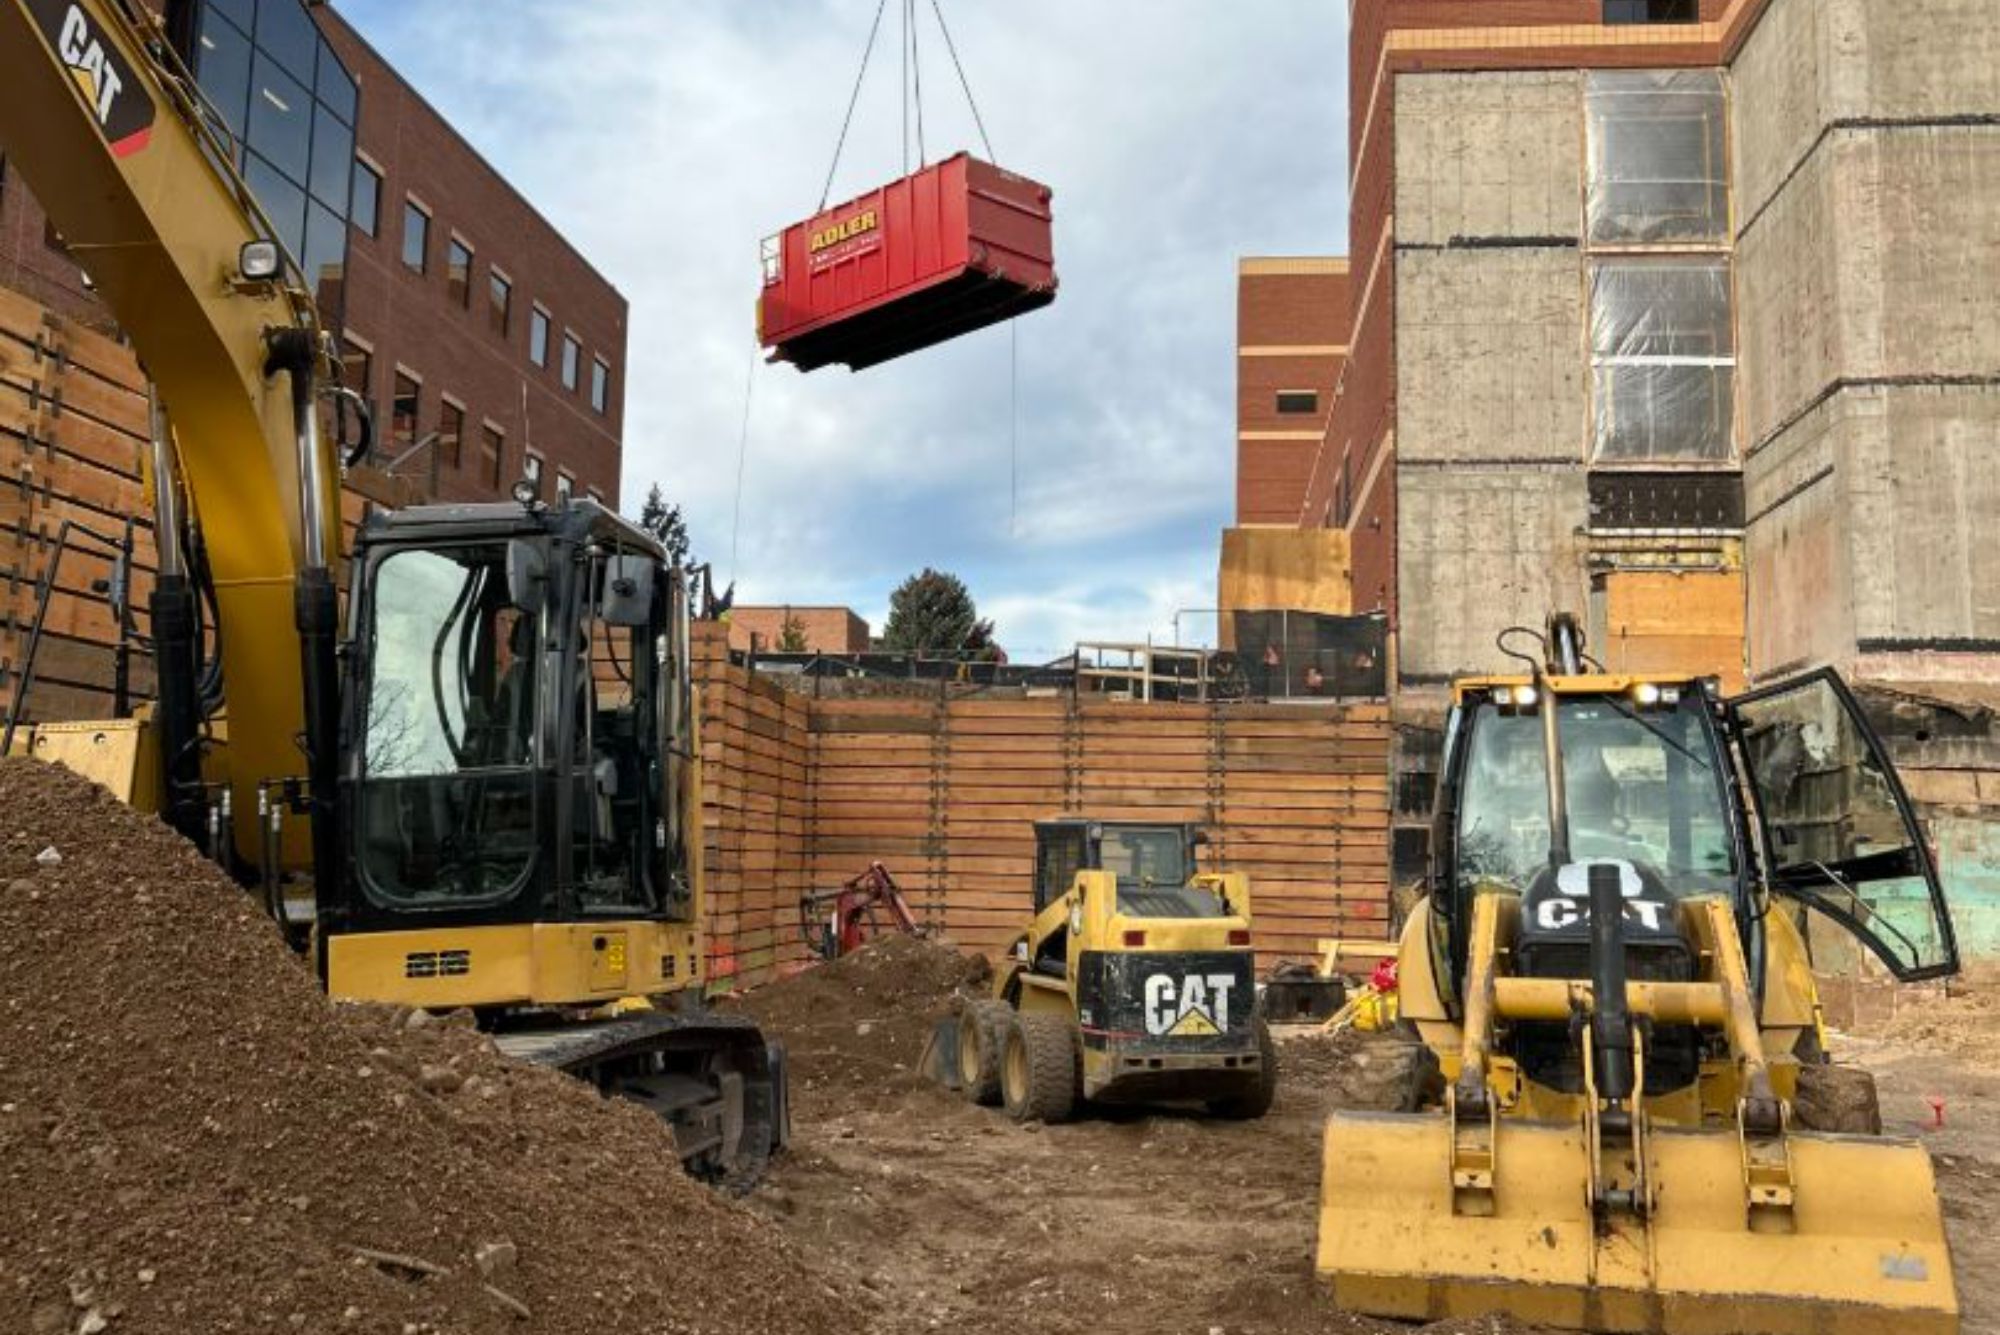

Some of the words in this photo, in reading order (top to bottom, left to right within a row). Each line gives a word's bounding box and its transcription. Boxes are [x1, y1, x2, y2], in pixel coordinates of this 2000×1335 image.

[59, 4, 122, 125] CAT
[809, 210, 878, 254] ADLER
[1538, 897, 1666, 932] CT
[1145, 973, 1236, 1036] CAT
